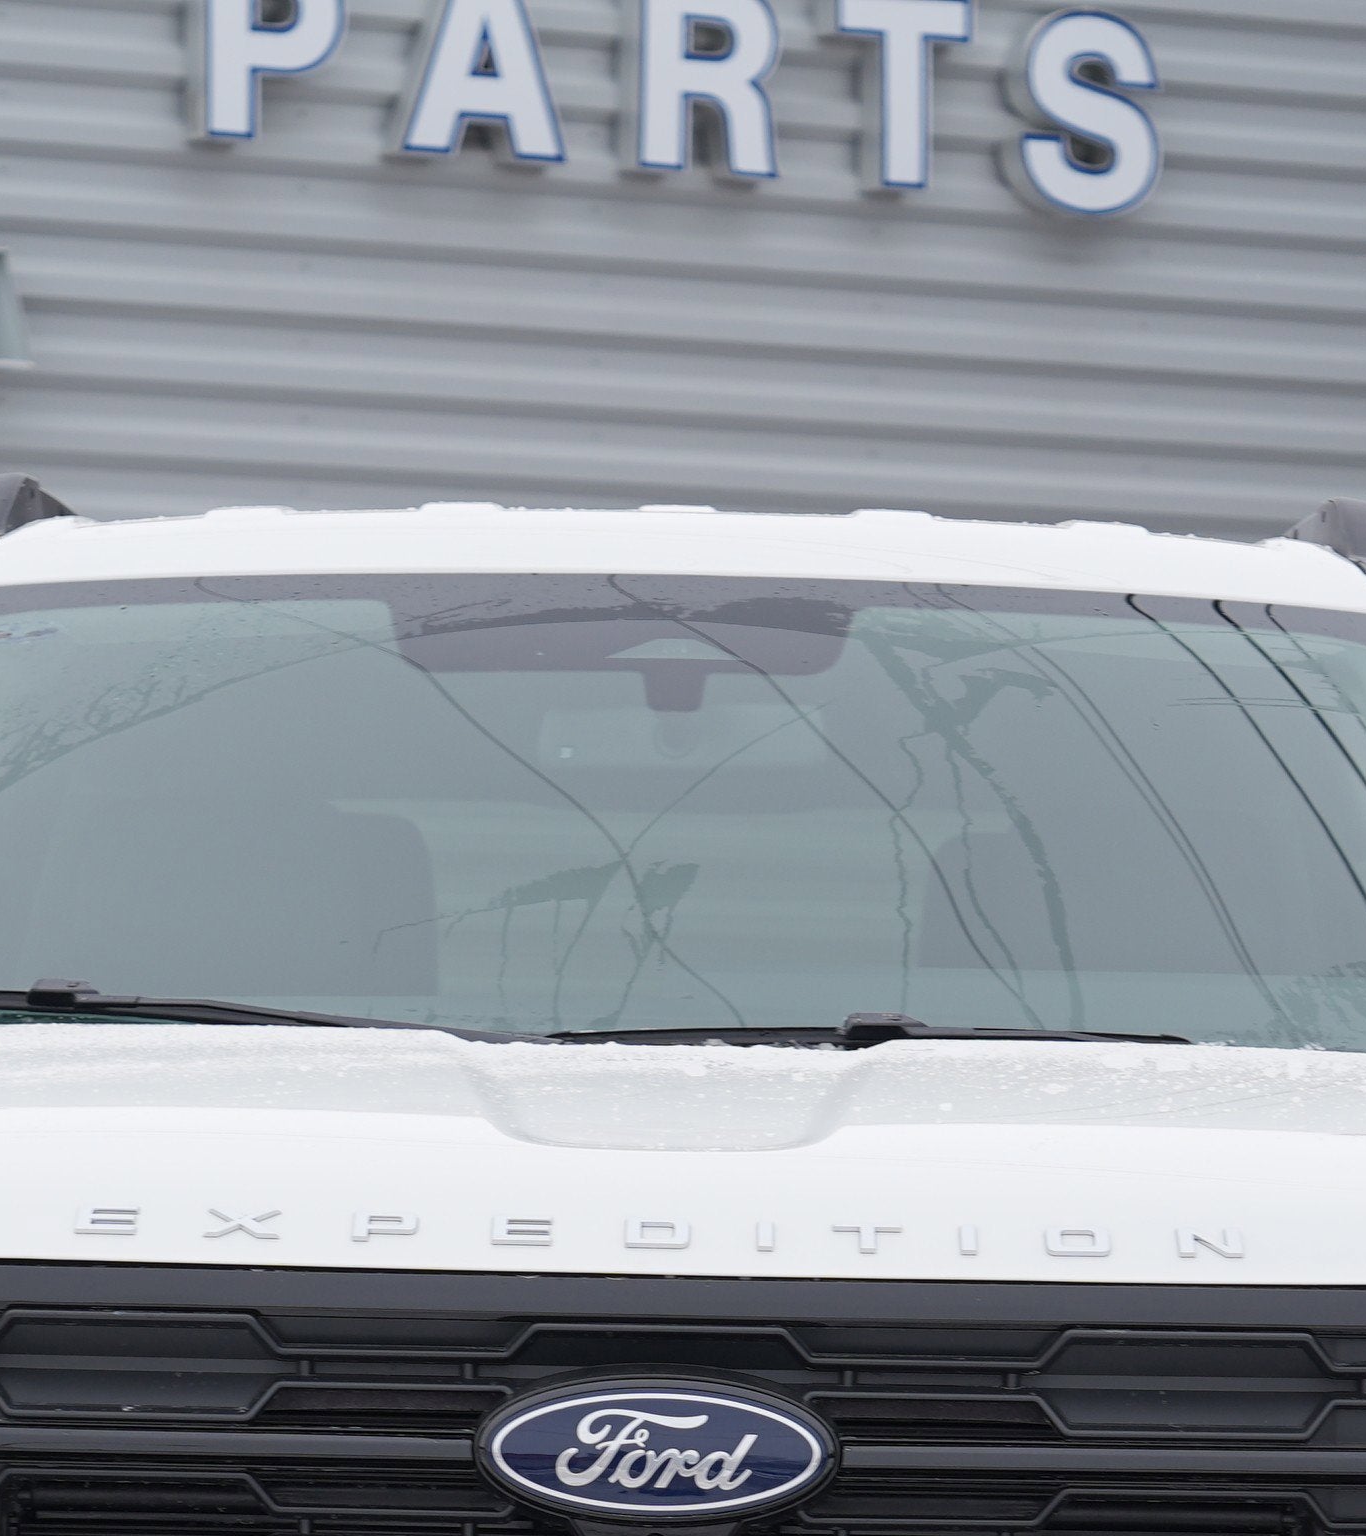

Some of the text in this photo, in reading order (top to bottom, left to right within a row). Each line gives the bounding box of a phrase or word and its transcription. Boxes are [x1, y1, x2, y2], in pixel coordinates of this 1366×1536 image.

[206, 0, 1159, 215] PARTS
[74, 1204, 1245, 1259] EXPEDITION
[555, 1408, 758, 1491] Ford
